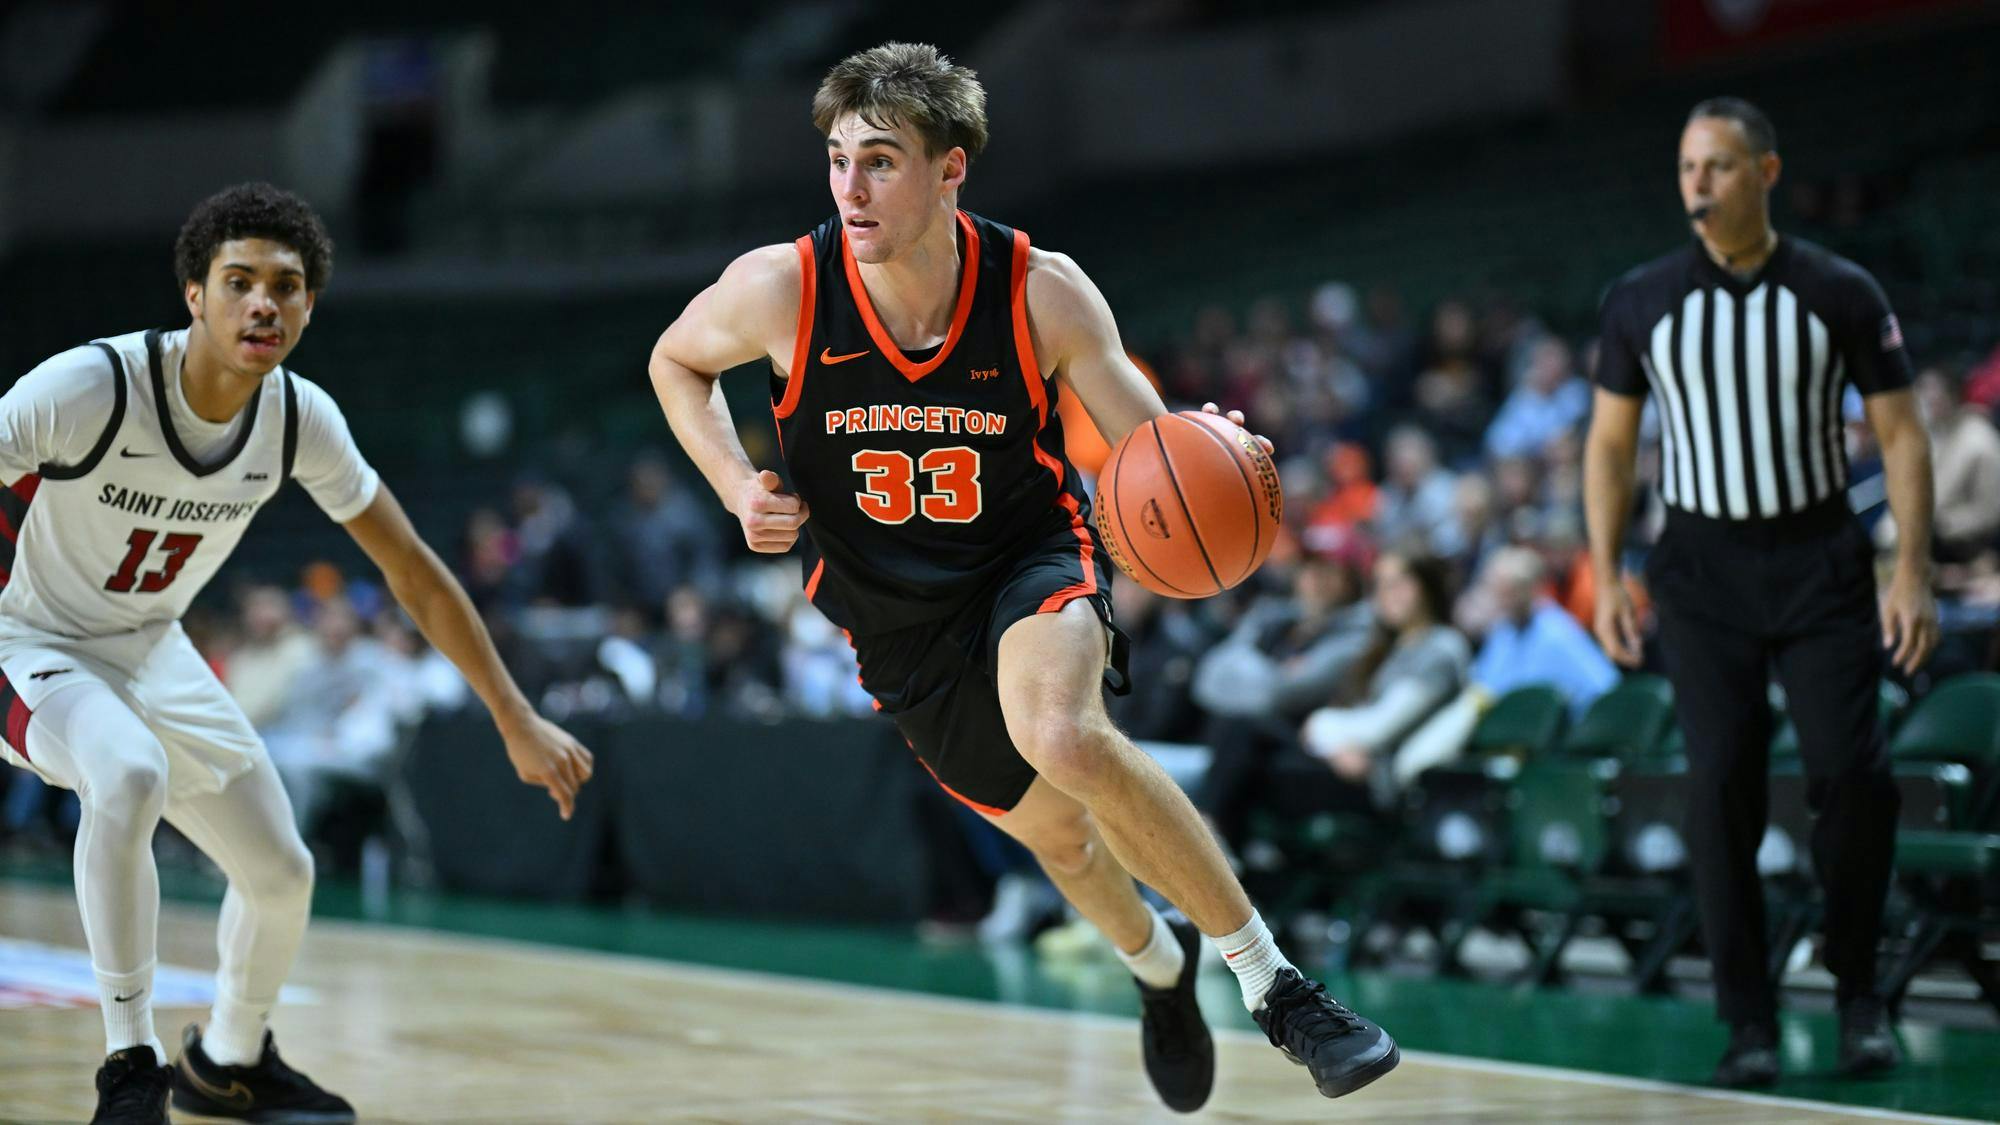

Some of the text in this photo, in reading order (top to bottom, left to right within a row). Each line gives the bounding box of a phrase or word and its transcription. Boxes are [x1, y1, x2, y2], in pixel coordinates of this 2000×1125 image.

[825, 405, 1006, 434] PRINCETON
[98, 483, 258, 522] SAINT JOSEPH'S
[852, 446, 982, 525] 33
[104, 528, 203, 592] 13
